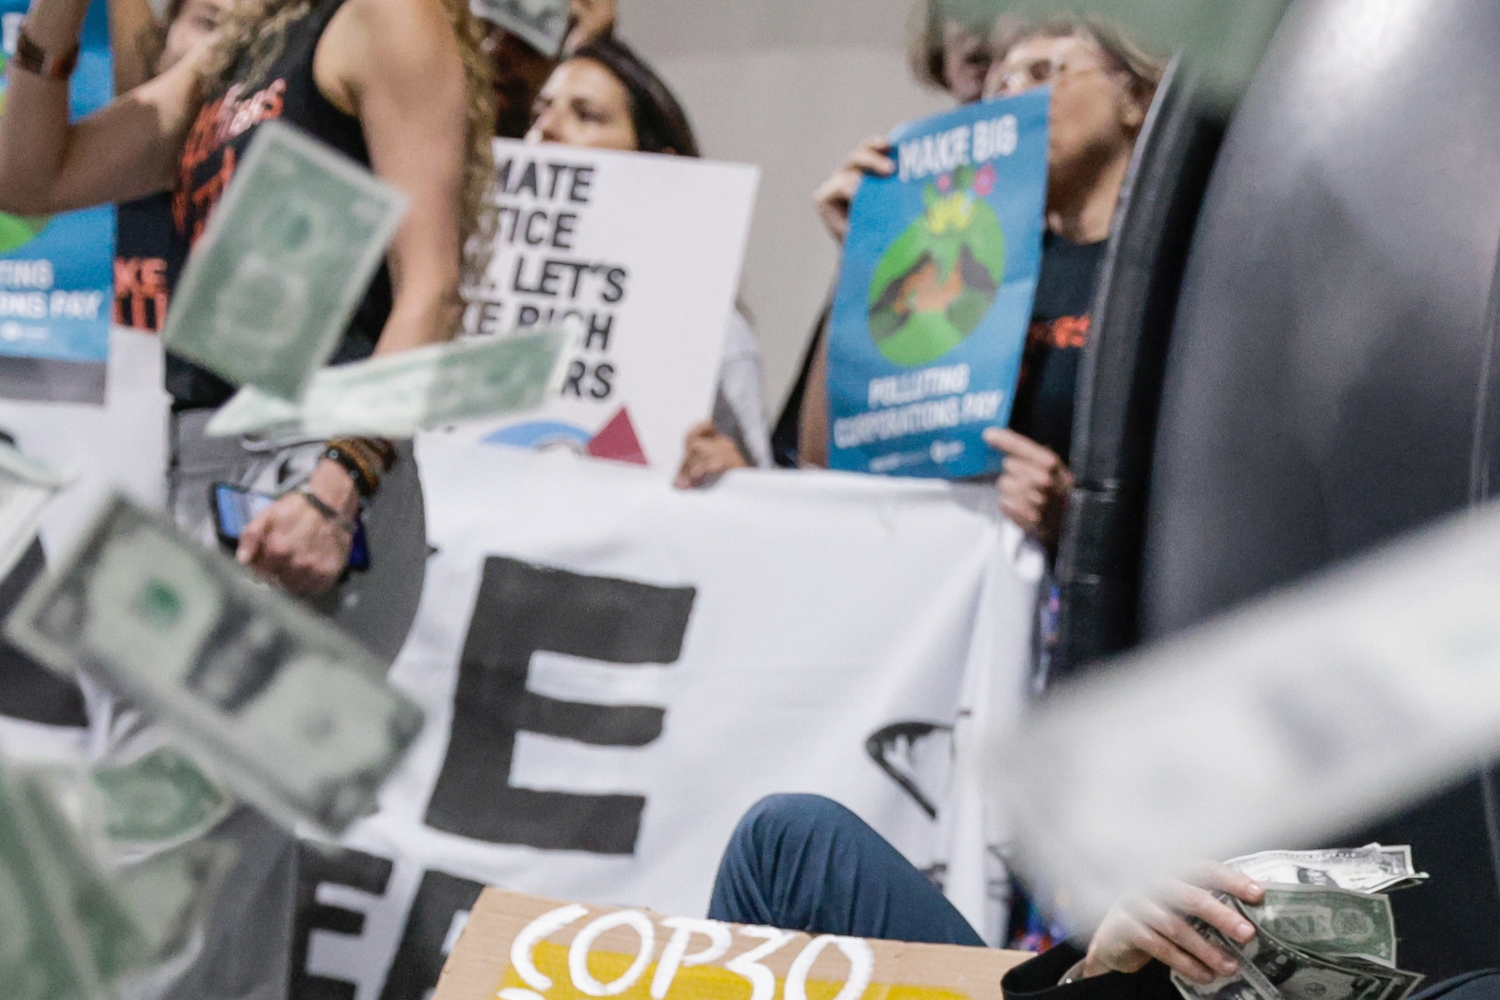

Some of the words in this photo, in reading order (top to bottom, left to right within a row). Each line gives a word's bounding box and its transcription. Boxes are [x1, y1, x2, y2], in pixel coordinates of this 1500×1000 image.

[900, 125, 971, 183] MAKE
[972, 113, 1018, 163] BIG
[512, 257, 627, 302] LET'S
